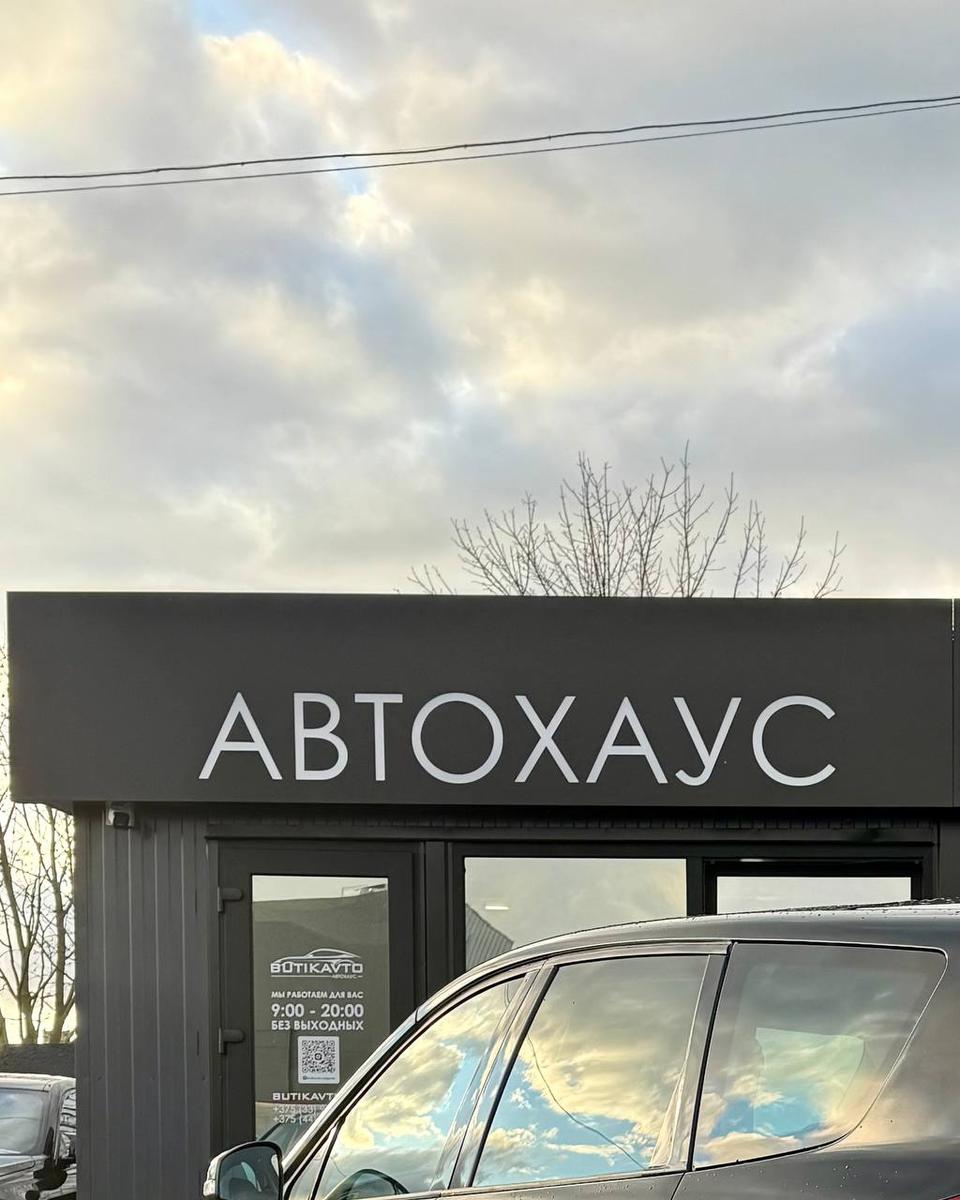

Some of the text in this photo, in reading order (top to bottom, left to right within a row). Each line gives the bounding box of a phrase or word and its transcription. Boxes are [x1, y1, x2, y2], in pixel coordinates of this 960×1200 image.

[199, 692, 836, 786] АВТОХАУС
[270, 962, 364, 973] BUTIKAVTO
[329, 991, 345, 999] ДЛЯ
[271, 1003, 304, 1017] 9:00
[321, 1003, 364, 1017] 20:00
[271, 1020, 364, 1031] БЕЗ ВЫХОДНЫХ
[272, 1092, 336, 1100] BUTIKAVT
[273, 1105, 296, 1113] +375
[273, 1114, 296, 1123] +375
